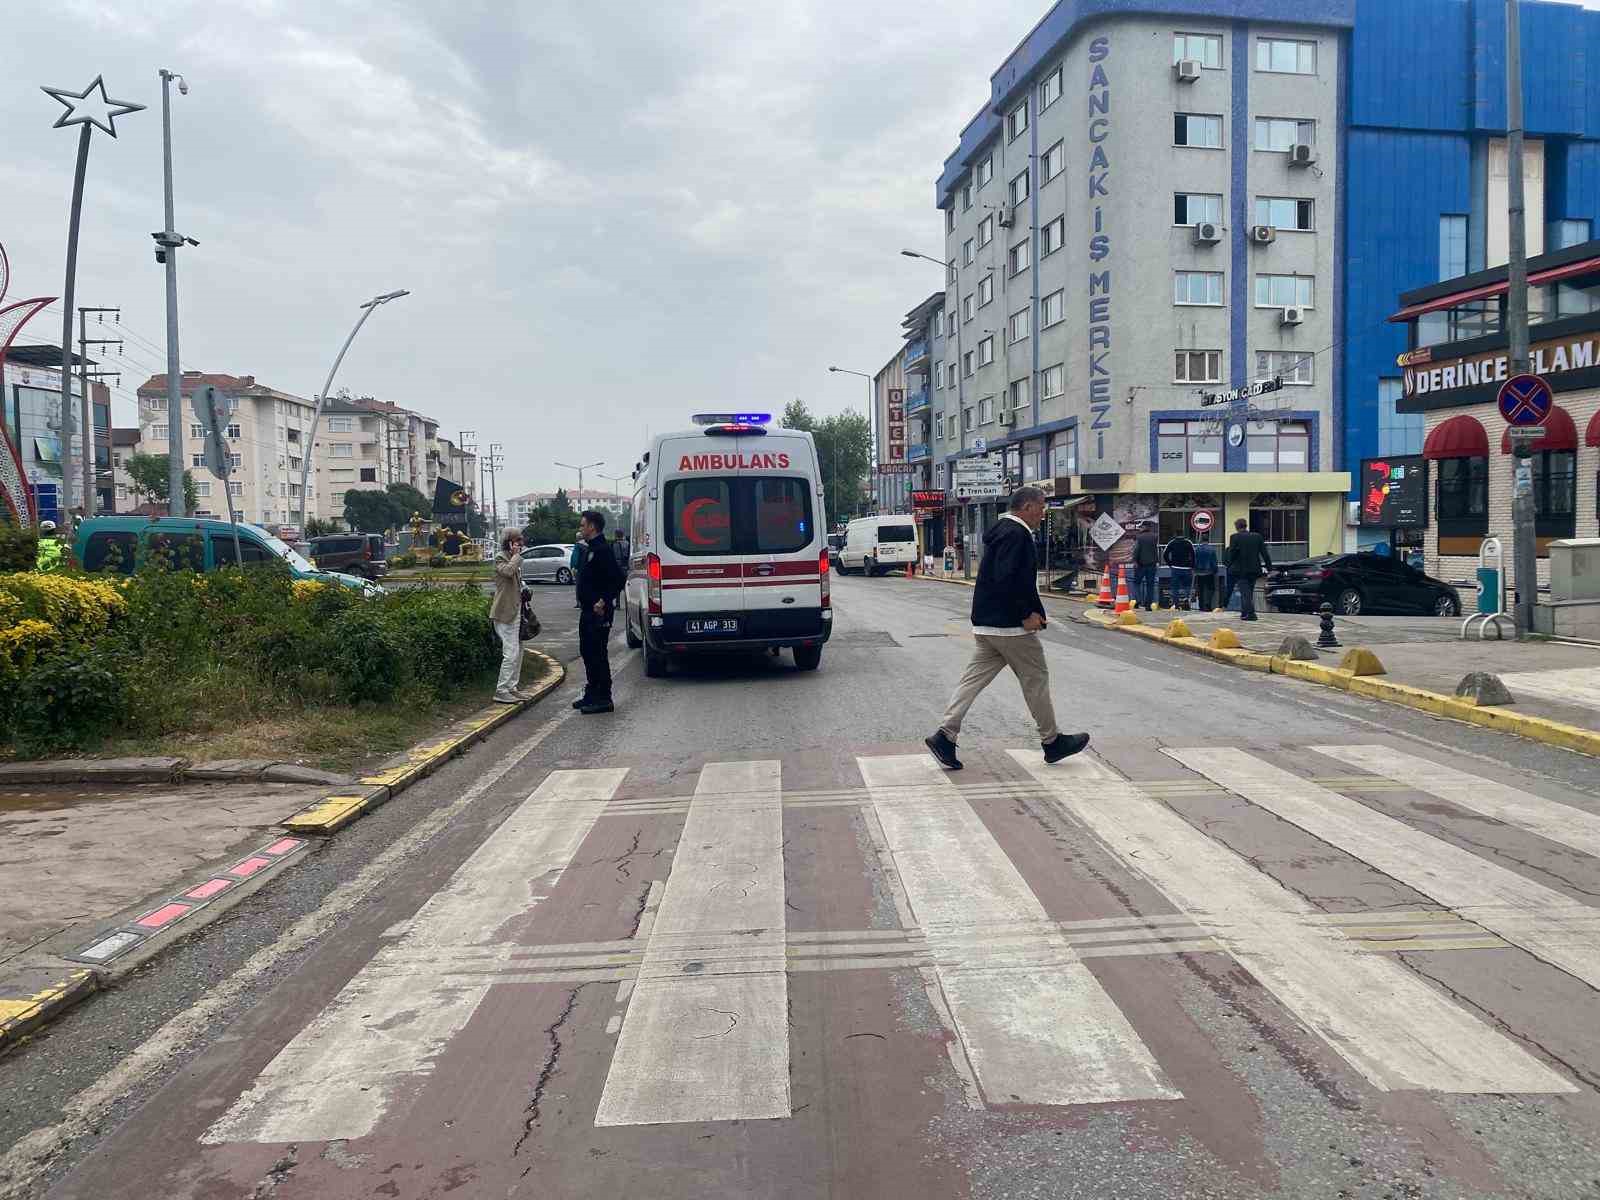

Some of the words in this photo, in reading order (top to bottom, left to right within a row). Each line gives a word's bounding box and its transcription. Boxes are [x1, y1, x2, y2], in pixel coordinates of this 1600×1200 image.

[1089, 37, 1109, 199] SANCAK
[1089, 271, 1112, 459] MERKEZİ
[1416, 357, 1508, 394] DERİNCE
[890, 391, 903, 459] OTEL
[679, 454, 790, 471] AMBULANS
[881, 464, 914, 474] SANCAK
[691, 622, 700, 631] 41
[703, 620, 718, 631] AGP
[722, 620, 736, 630] 313
